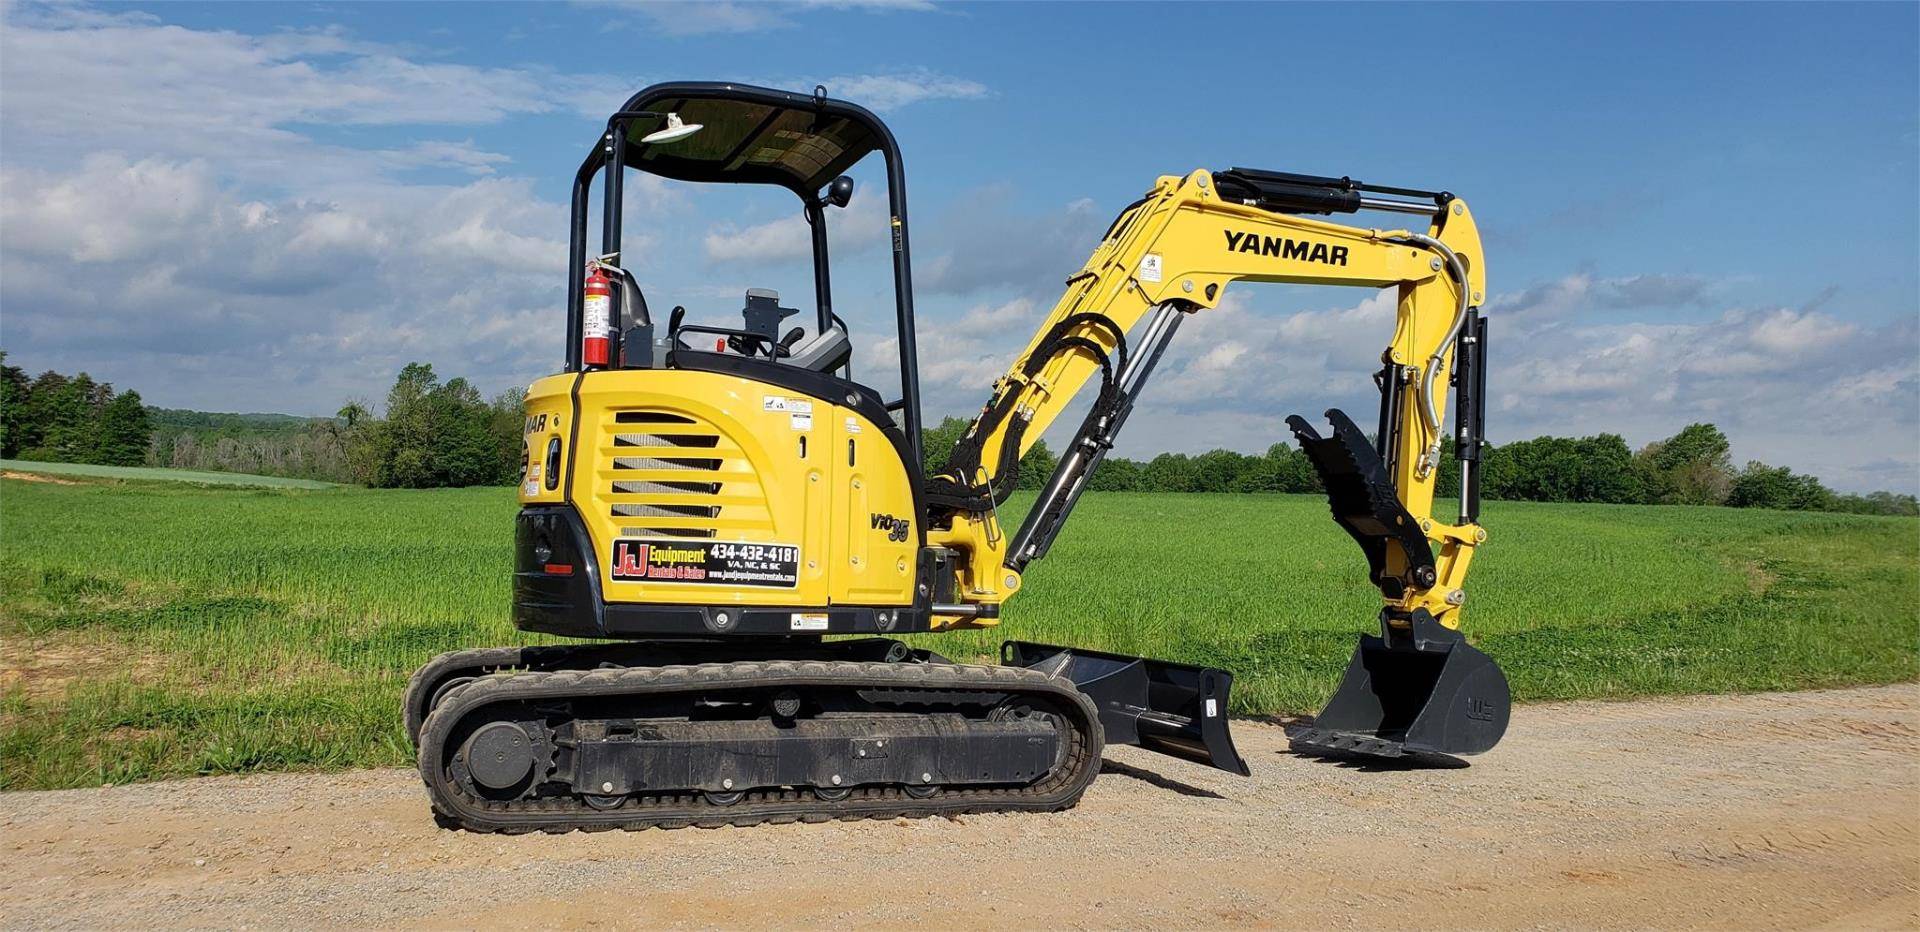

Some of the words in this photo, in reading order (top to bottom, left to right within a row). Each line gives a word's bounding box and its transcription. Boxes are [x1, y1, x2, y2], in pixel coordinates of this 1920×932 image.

[1224, 230, 1349, 266] YANMAR
[613, 544, 649, 576] J&J
[649, 546, 706, 566] Equipment
[710, 544, 798, 562] 434-432-4181
[647, 565, 677, 578] Rentals
[677, 566, 684, 578] &
[684, 566, 706, 579] Sales
[727, 560, 743, 568] VA,
[744, 561, 759, 569] NC,
[769, 562, 781, 570] SC
